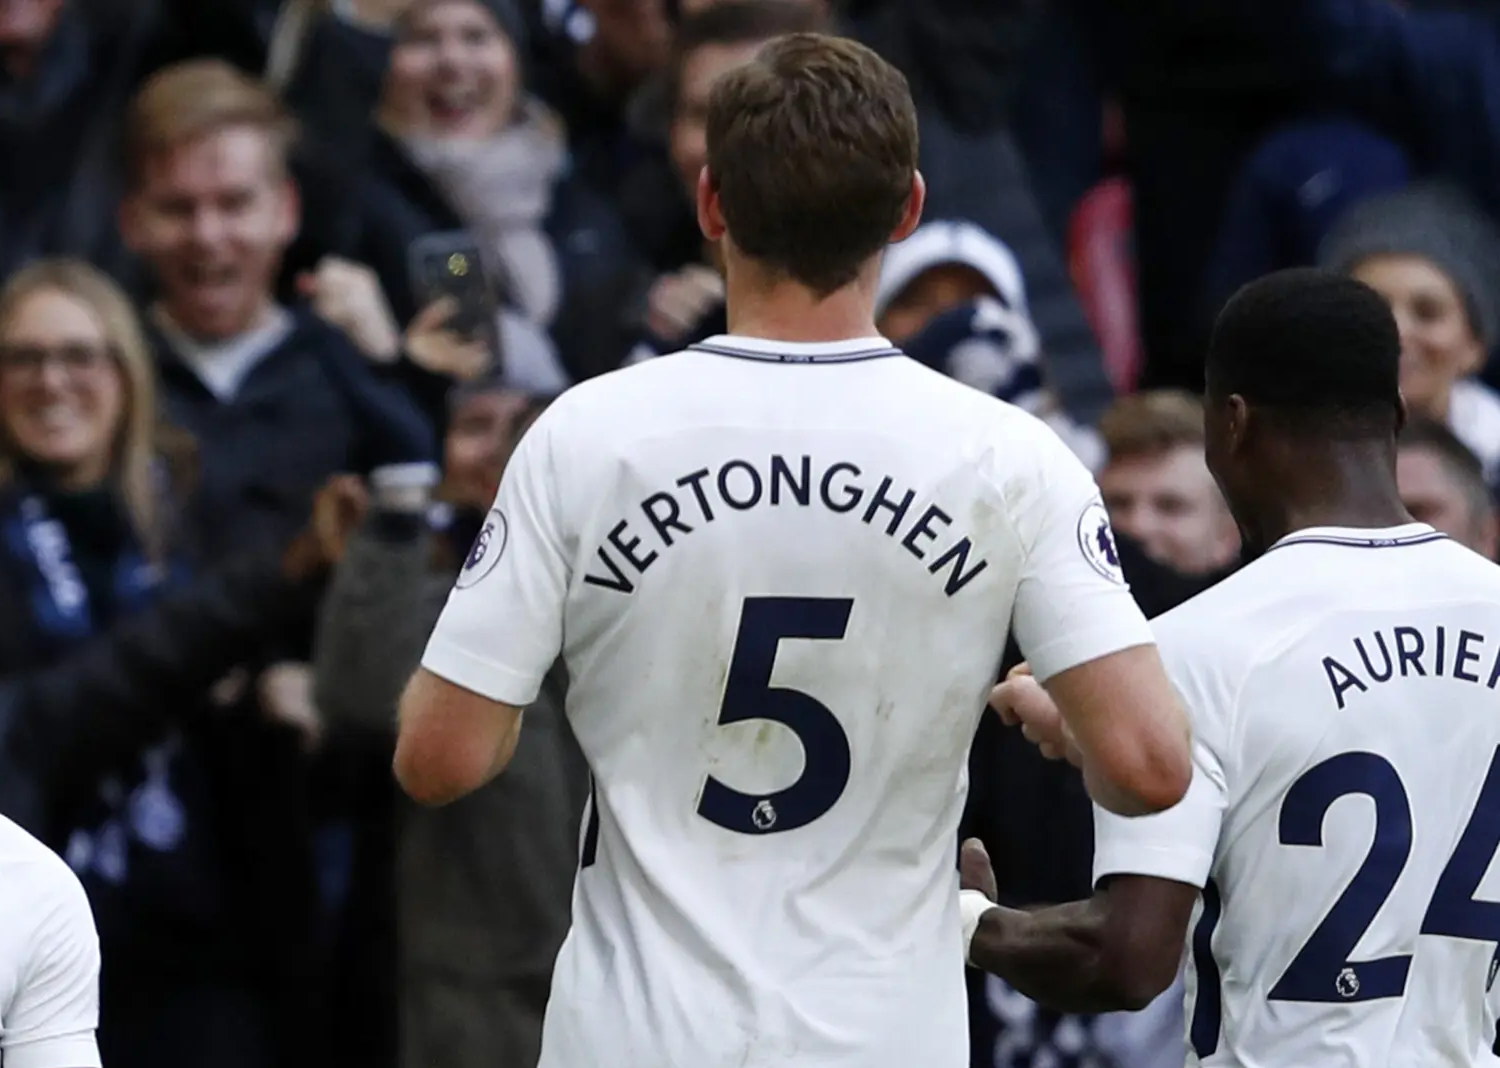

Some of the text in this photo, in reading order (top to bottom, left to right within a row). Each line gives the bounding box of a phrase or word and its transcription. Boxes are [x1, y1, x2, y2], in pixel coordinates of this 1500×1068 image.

[583, 454, 988, 599] VERTONGHEN
[696, 596, 856, 836] 5
[1265, 742, 1500, 1004] 24
